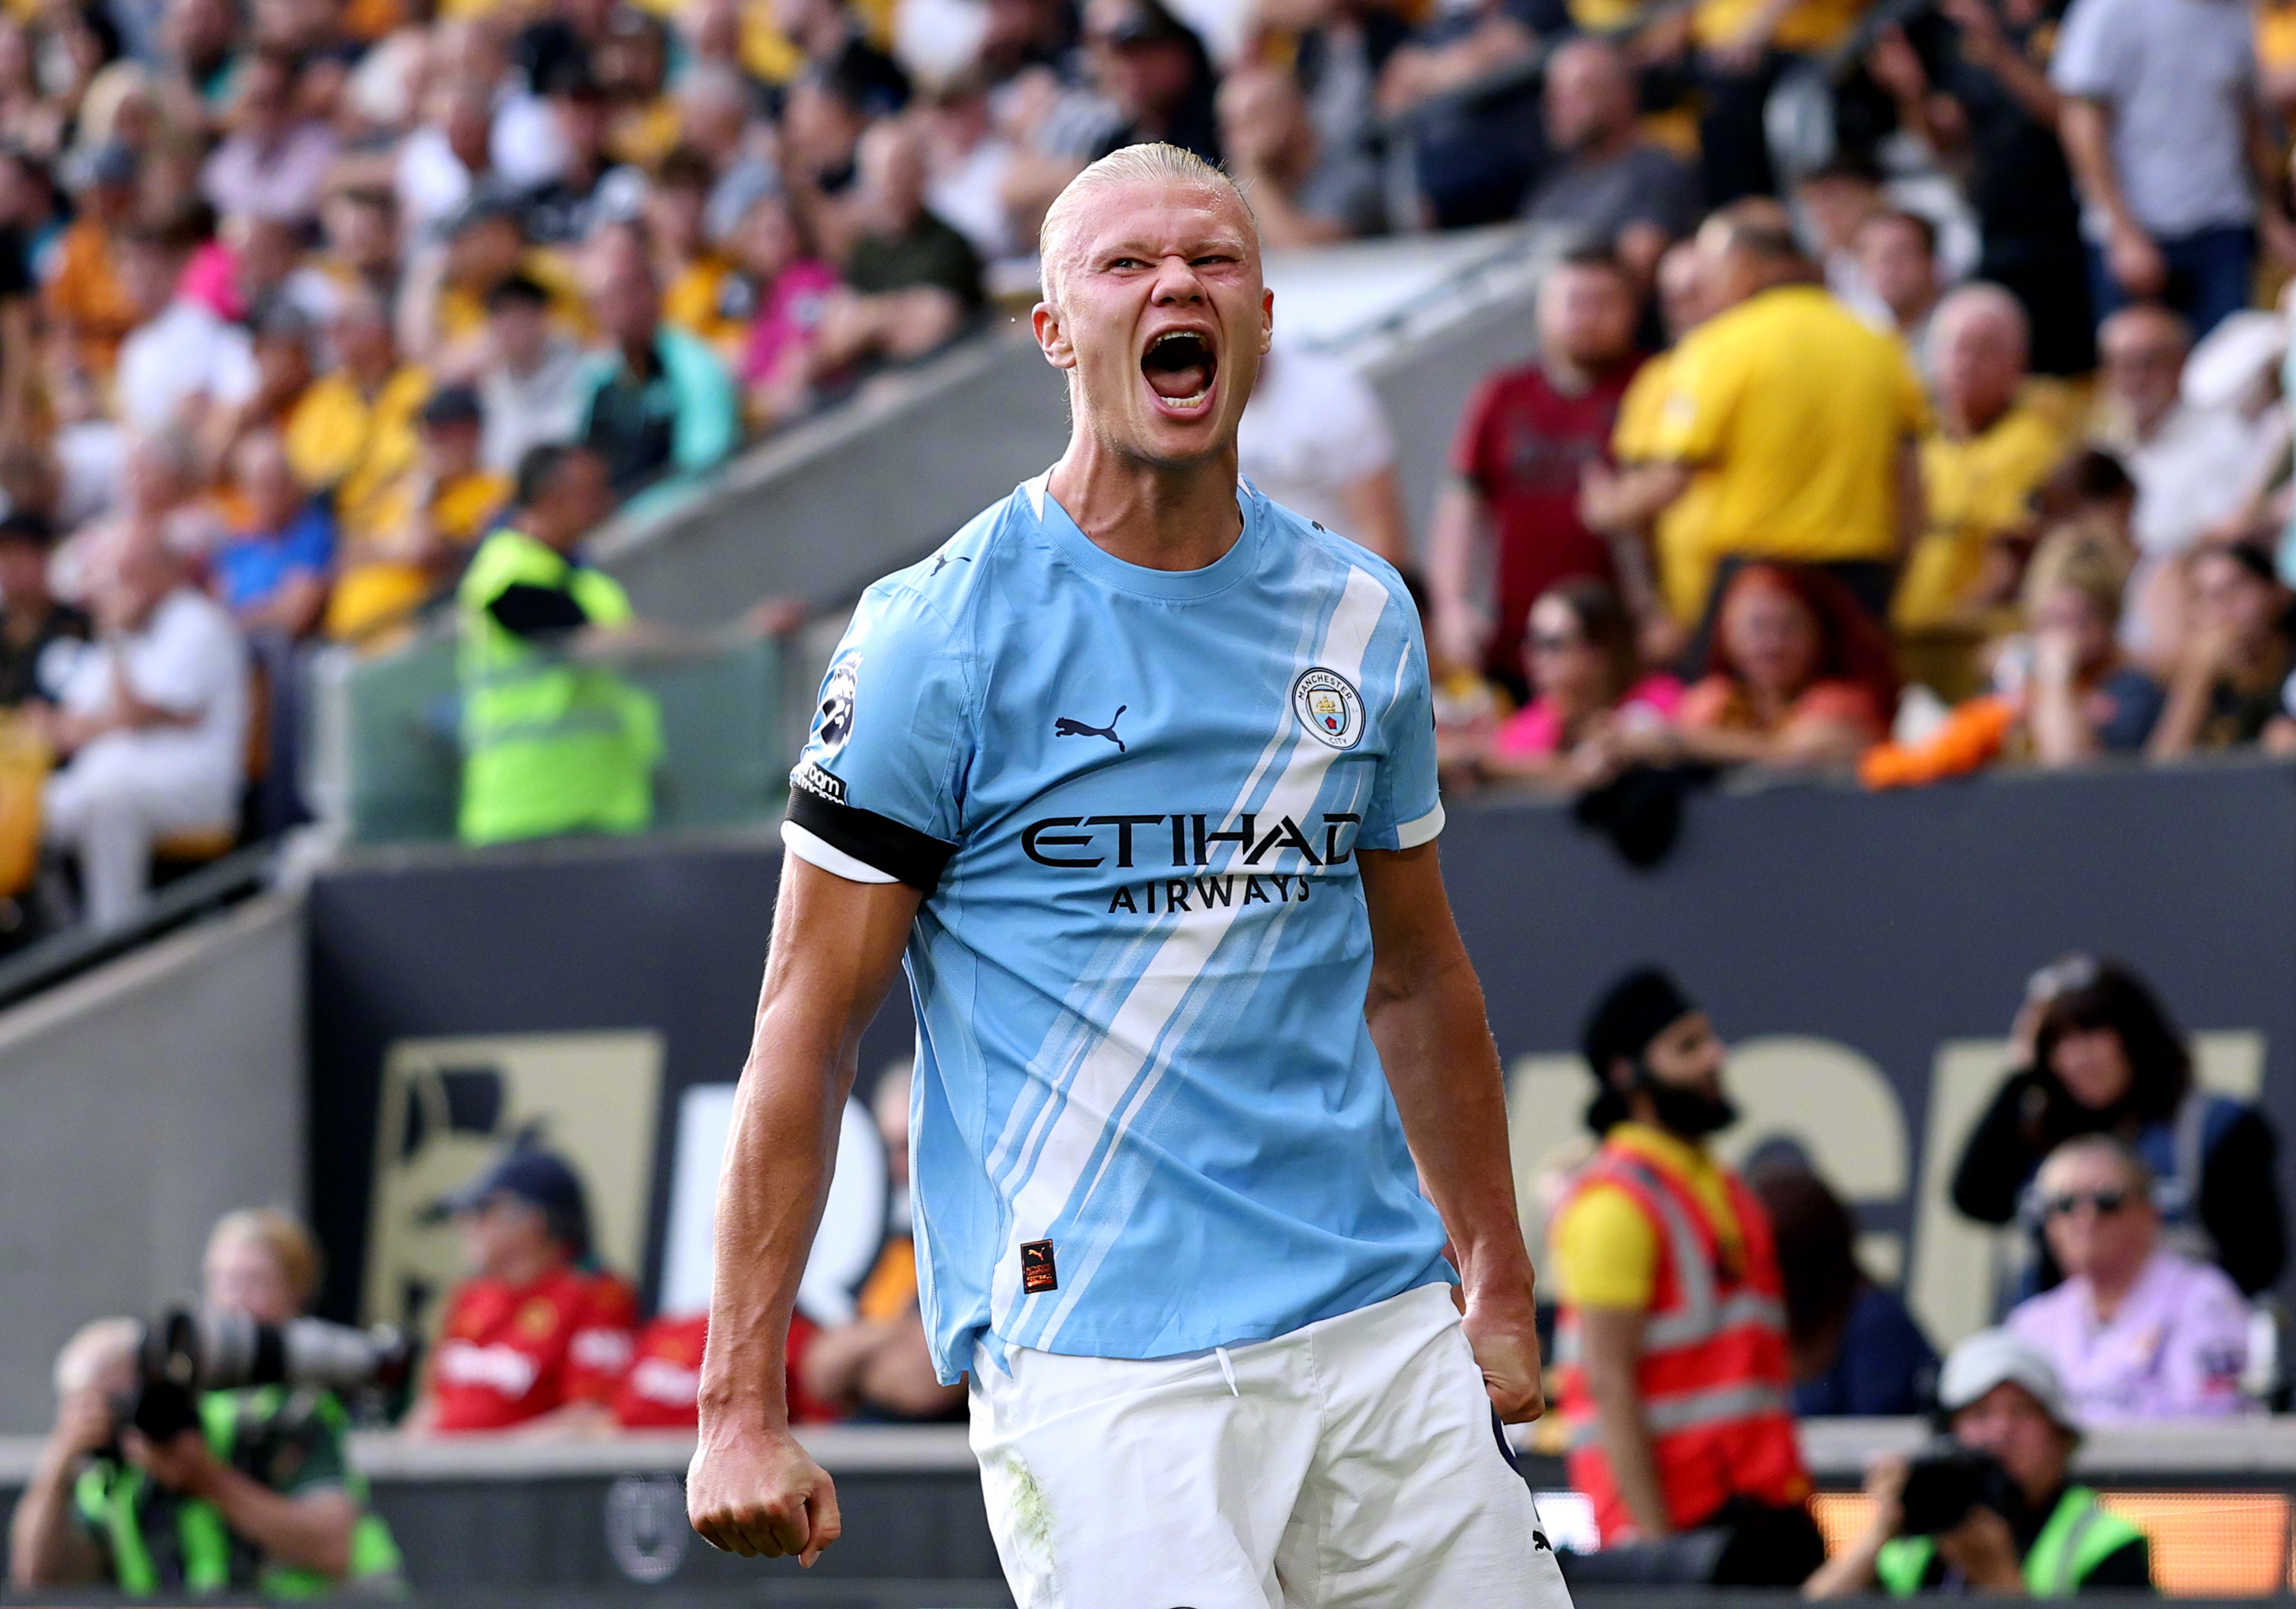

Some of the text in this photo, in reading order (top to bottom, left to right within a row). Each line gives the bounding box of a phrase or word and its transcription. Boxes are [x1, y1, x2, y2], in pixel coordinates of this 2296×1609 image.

[1298, 675, 1352, 700] MANCHESTER
[1021, 813, 1361, 868] ETIHAD
[1108, 874, 1310, 914] AIRWAYS
